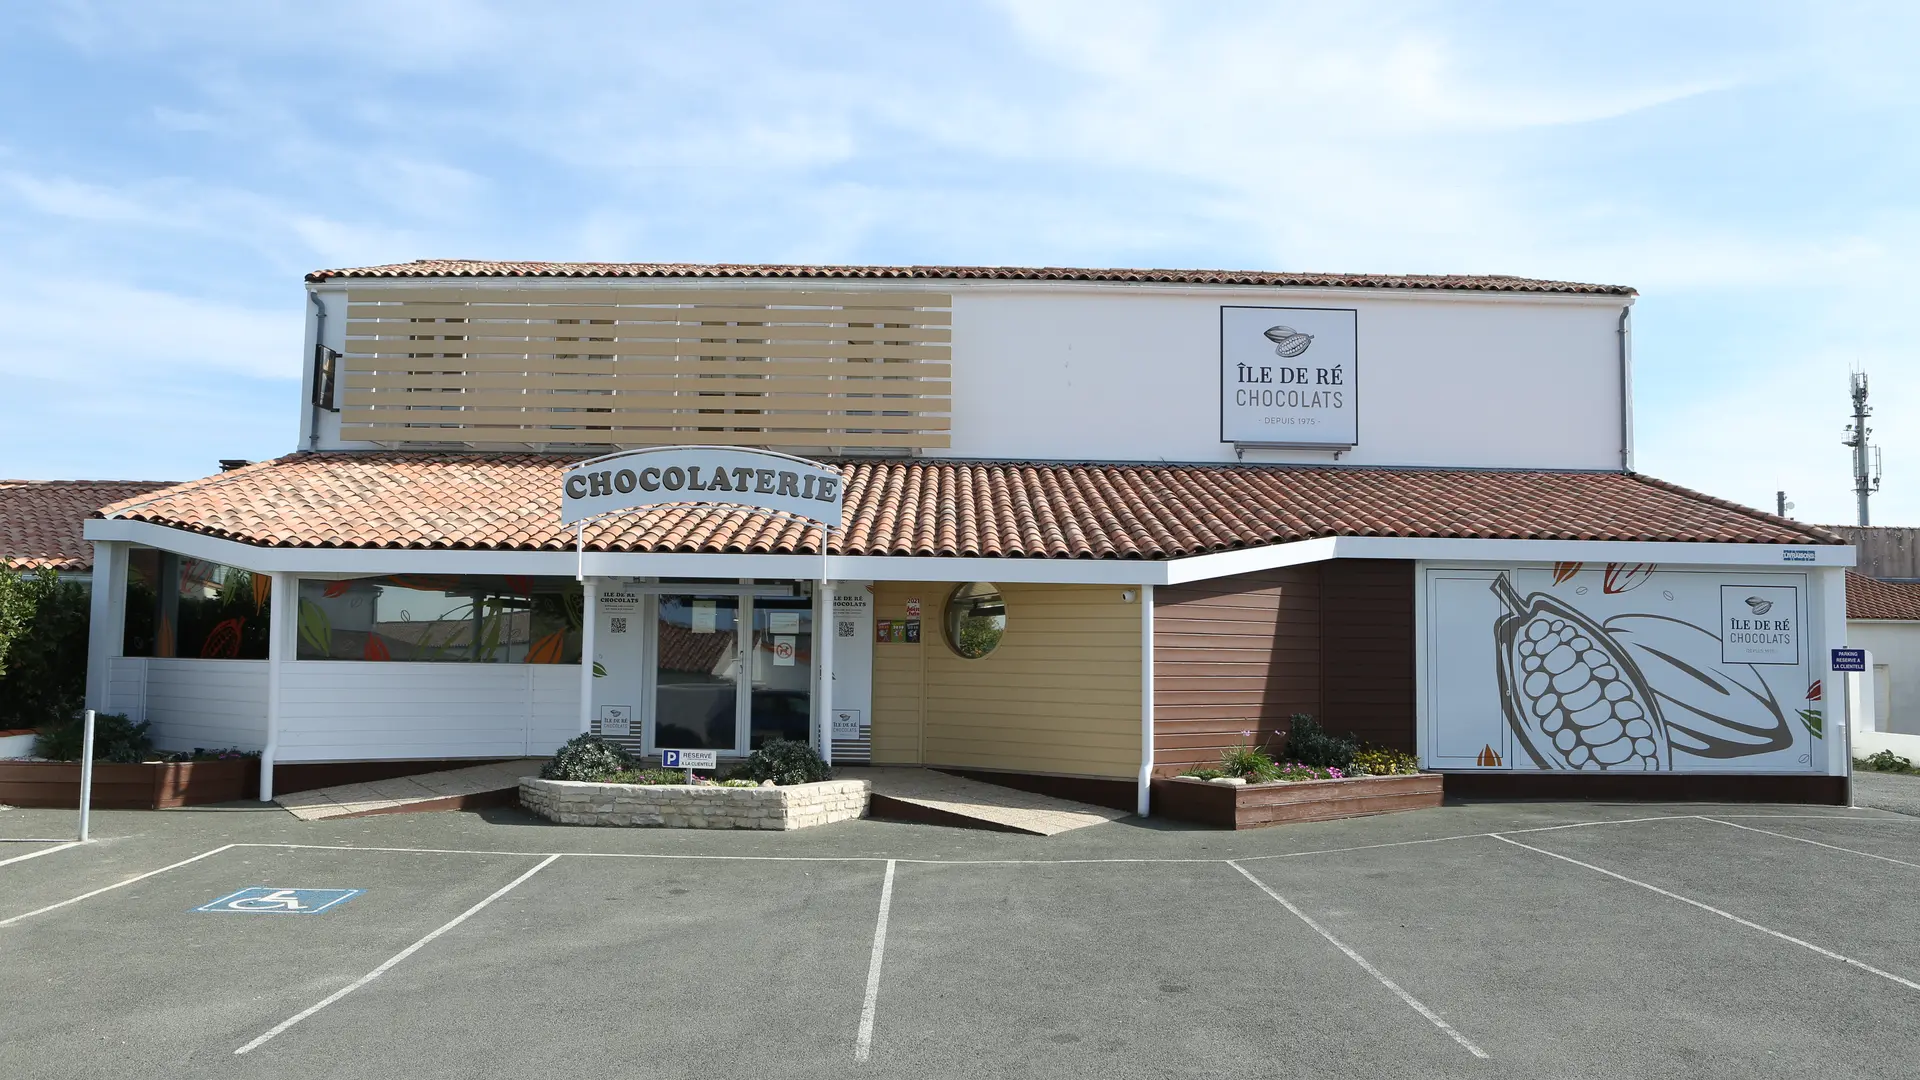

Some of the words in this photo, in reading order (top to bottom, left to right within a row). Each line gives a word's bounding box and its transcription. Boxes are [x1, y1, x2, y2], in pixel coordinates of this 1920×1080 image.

[1236, 362, 1272, 384] ÎLE
[1279, 366, 1309, 385] DE
[1315, 364, 1343, 385] RÉ
[1236, 388, 1343, 409] CHOCOLATS
[1264, 416, 1295, 425] DEPUIS
[1298, 418, 1316, 426] 1975
[565, 465, 838, 502] CHOCOLATERIE
[1730, 618, 1751, 630] ÎLE
[1754, 620, 1771, 631] DE
[1774, 618, 1790, 631] RÉ
[1730, 632, 1790, 645] CHOCOLATS
[667, 751, 677, 765] P
